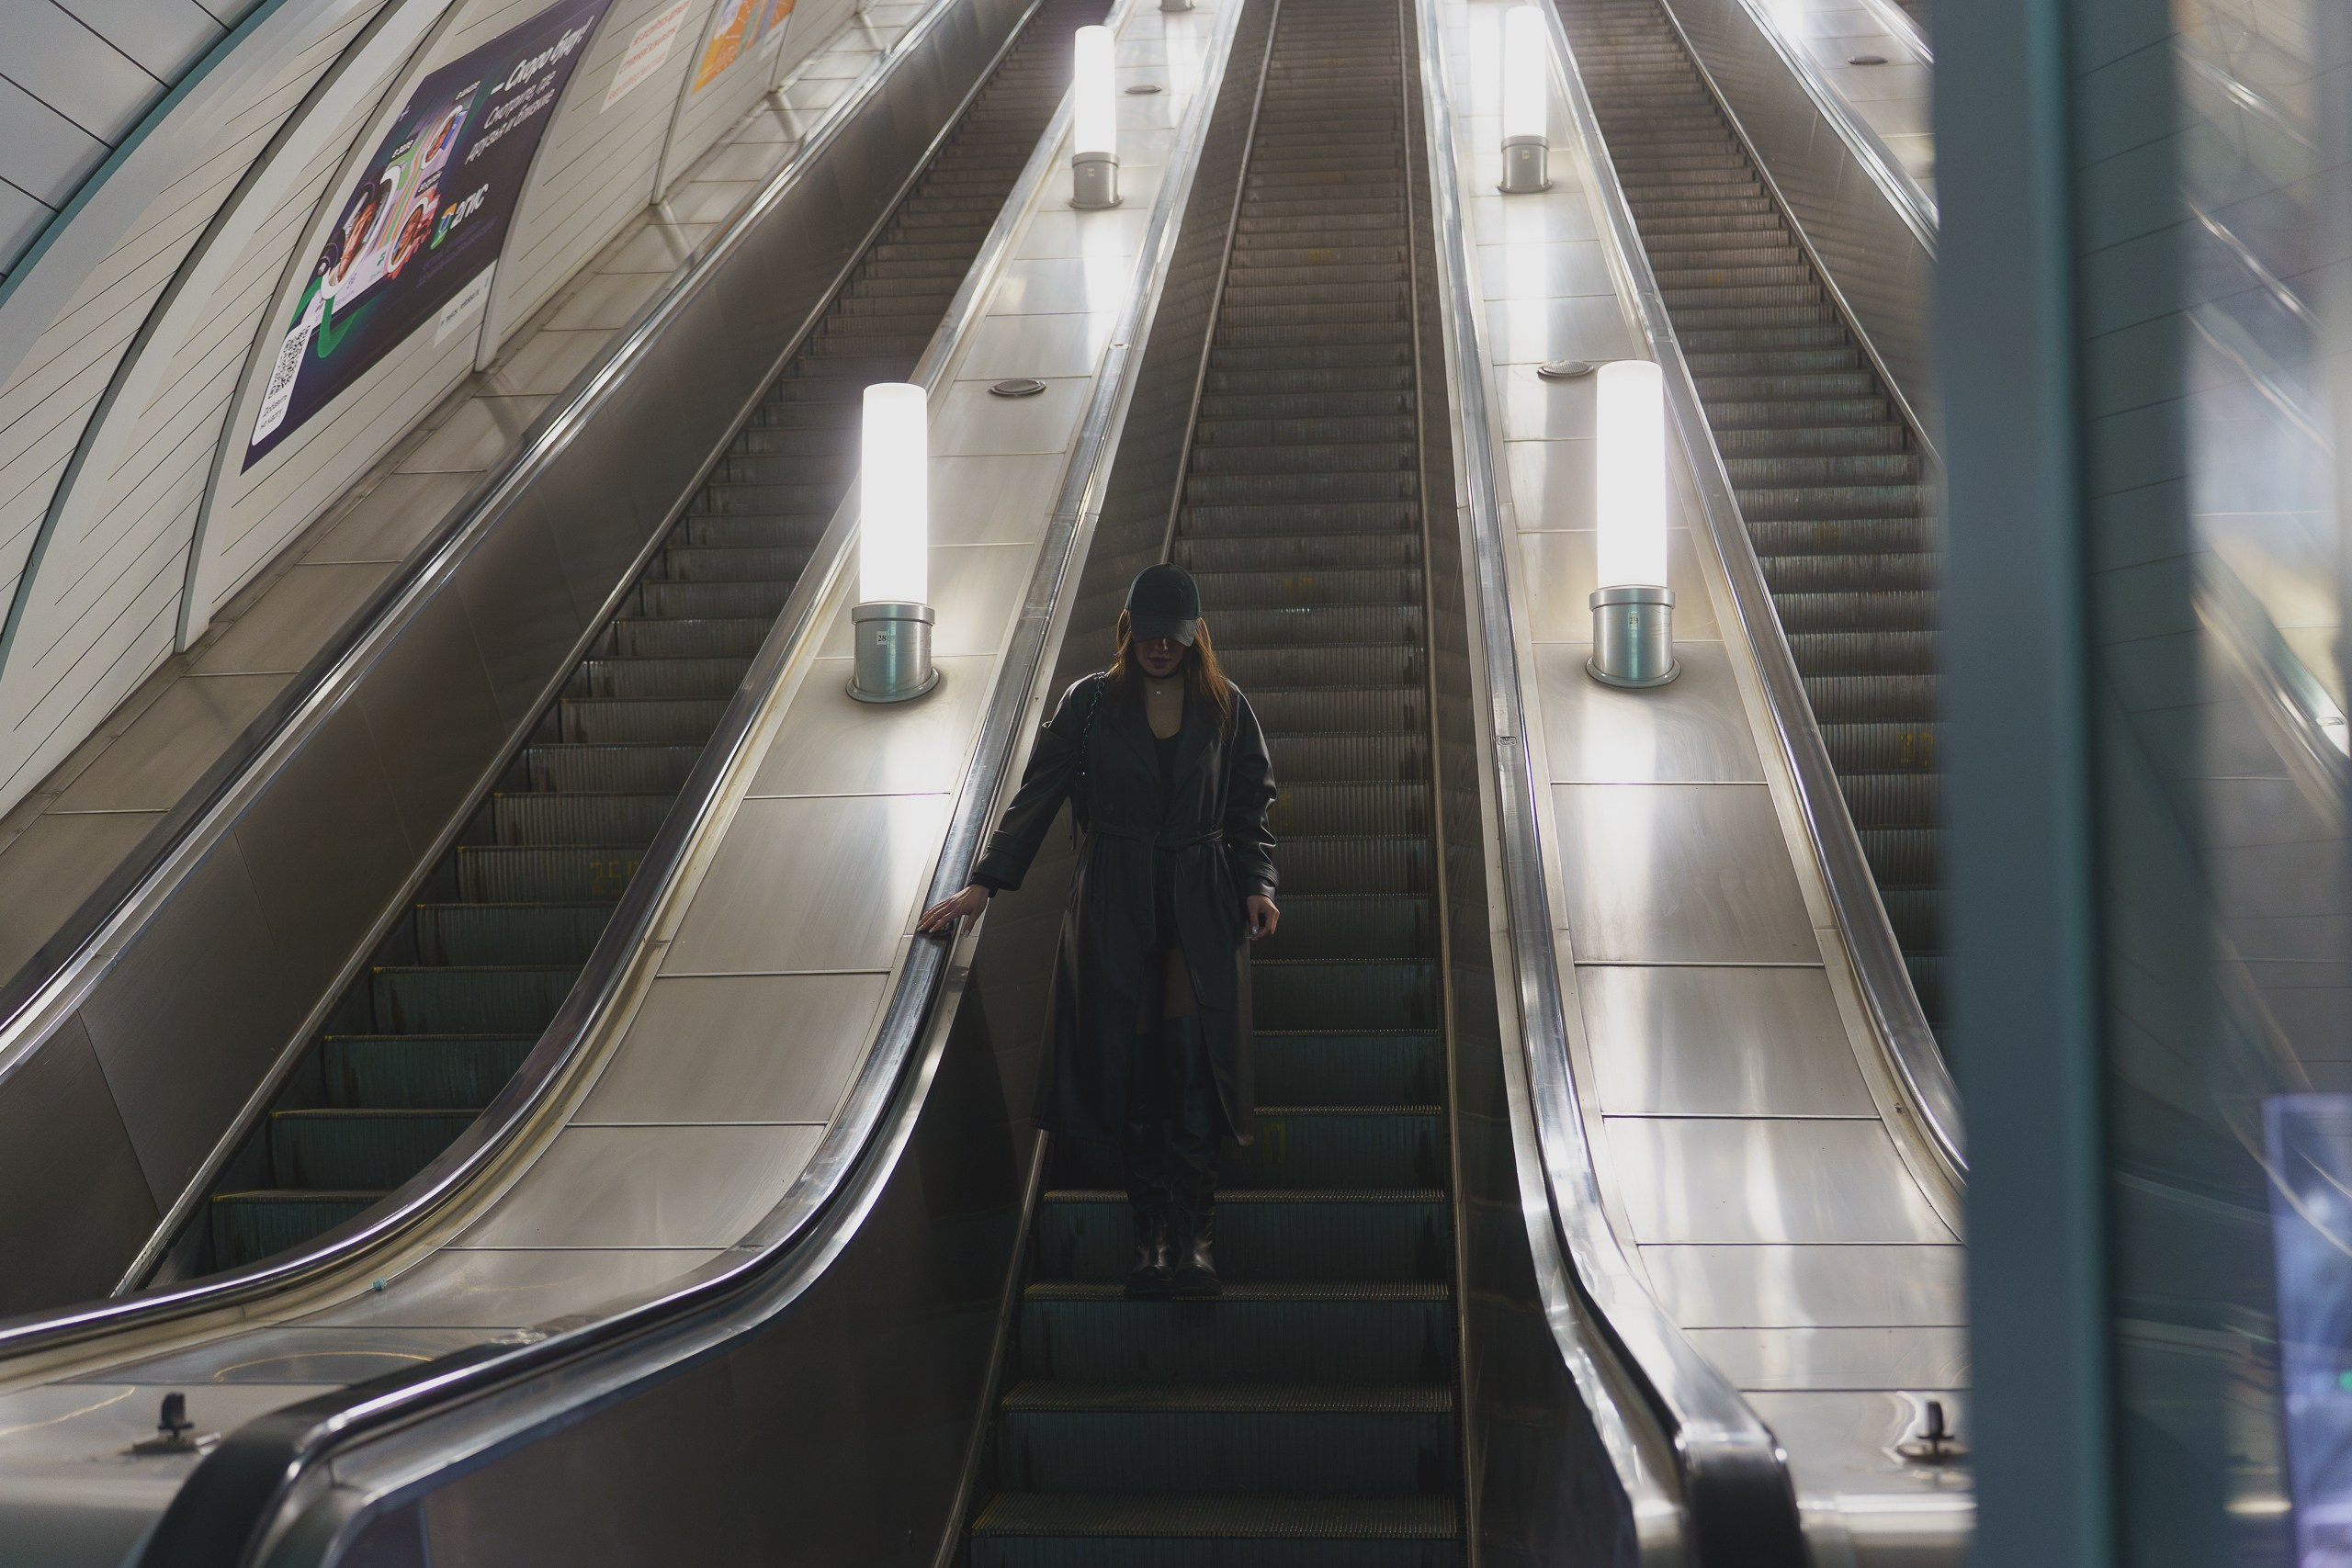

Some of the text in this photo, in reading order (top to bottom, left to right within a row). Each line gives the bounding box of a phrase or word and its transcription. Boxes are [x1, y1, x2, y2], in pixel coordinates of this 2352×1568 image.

[504, 47, 554, 92] Скоро
[549, 15, 595, 65] буду!
[464, 88, 556, 165] друзья и близкие
[483, 71, 557, 130] Смотрите, где
[450, 183, 489, 230] 2ГИС
[877, 634, 887, 642] 28
